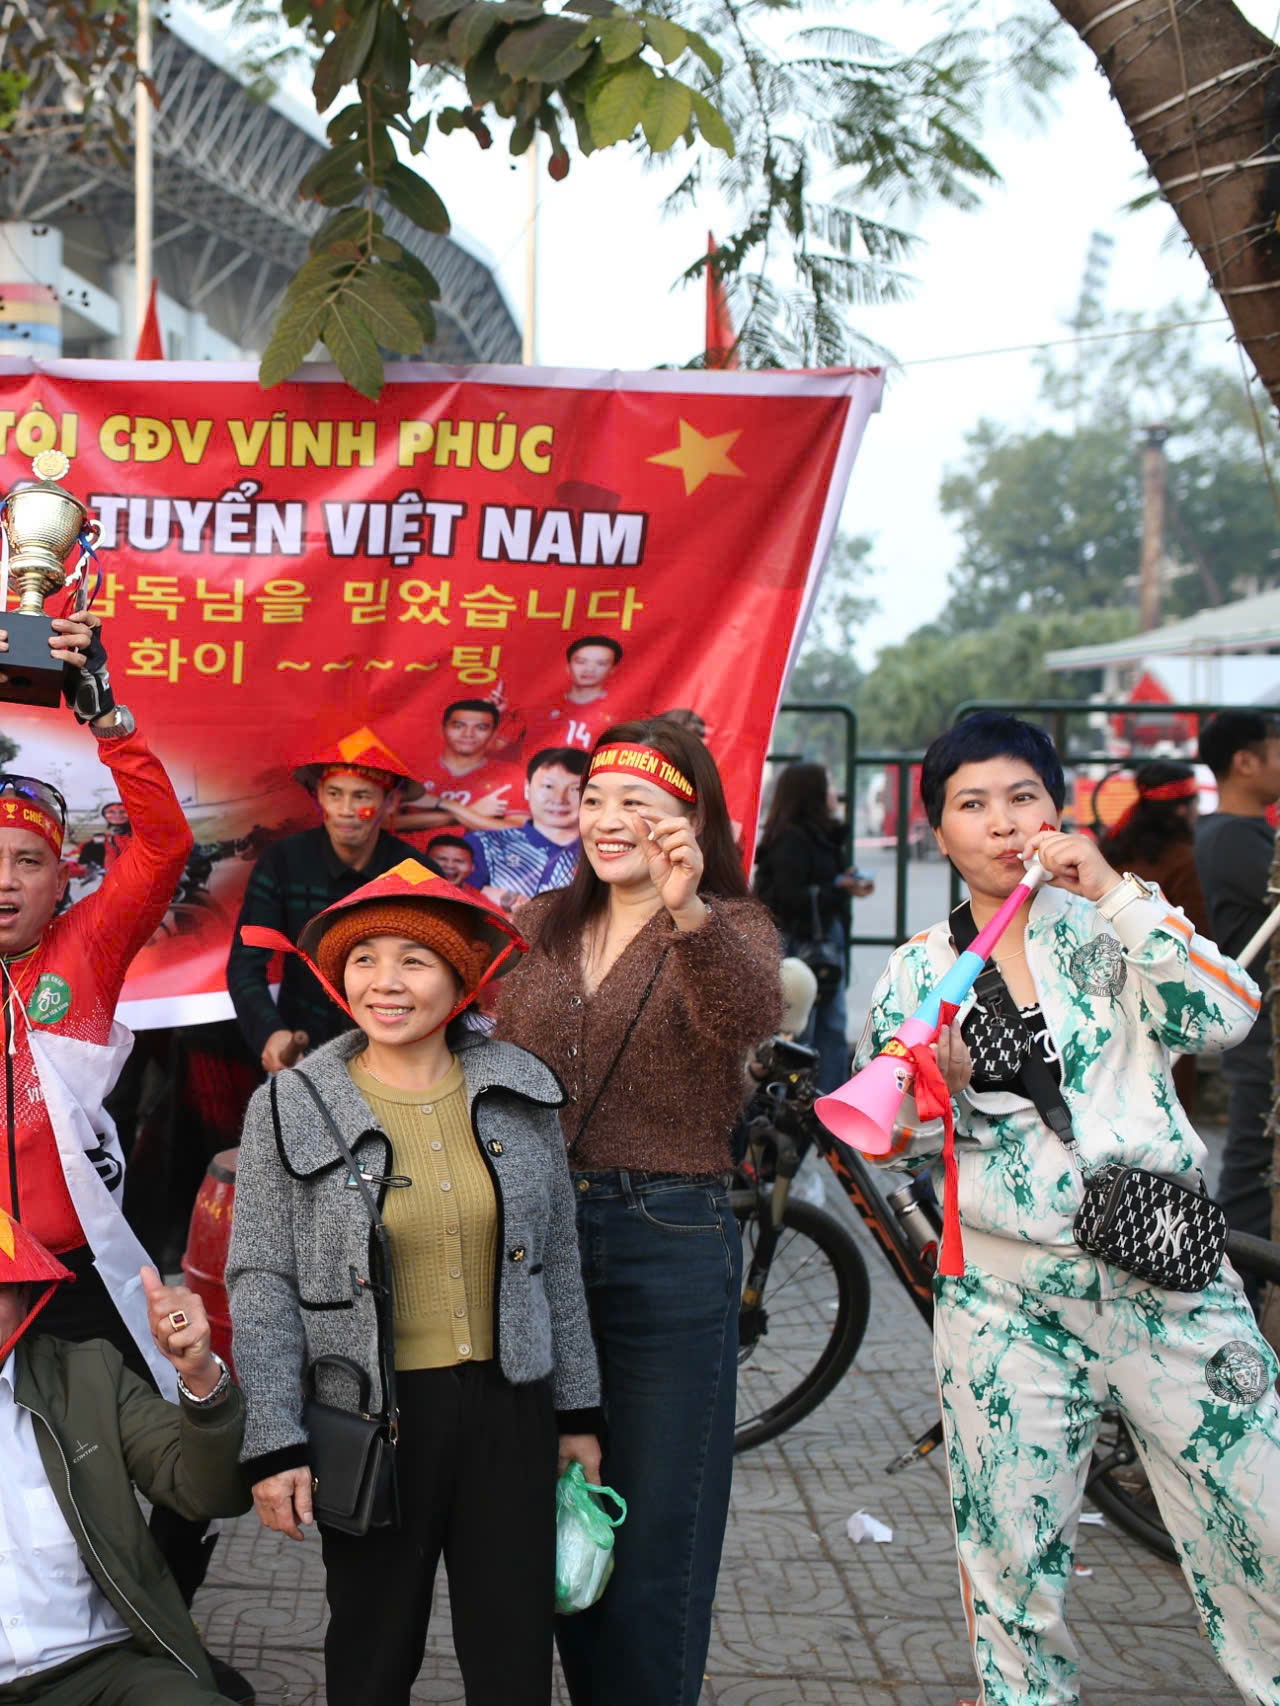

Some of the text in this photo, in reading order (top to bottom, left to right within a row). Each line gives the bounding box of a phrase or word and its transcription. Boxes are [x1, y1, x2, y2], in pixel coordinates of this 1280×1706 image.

[99, 414, 213, 465] CĐV
[227, 411, 377, 468] VĨNH
[397, 411, 555, 475] PHÚC
[89, 481, 304, 556] TUYỂN
[324, 491, 465, 566] VIỆT
[481, 506, 645, 566] NAM
[343, 578, 644, 631] 믿었습니다
[126, 637, 244, 684] 화이
[451, 645, 502, 685] 팅
[566, 719, 592, 748] 14
[617, 749, 660, 775] CHIẾN
